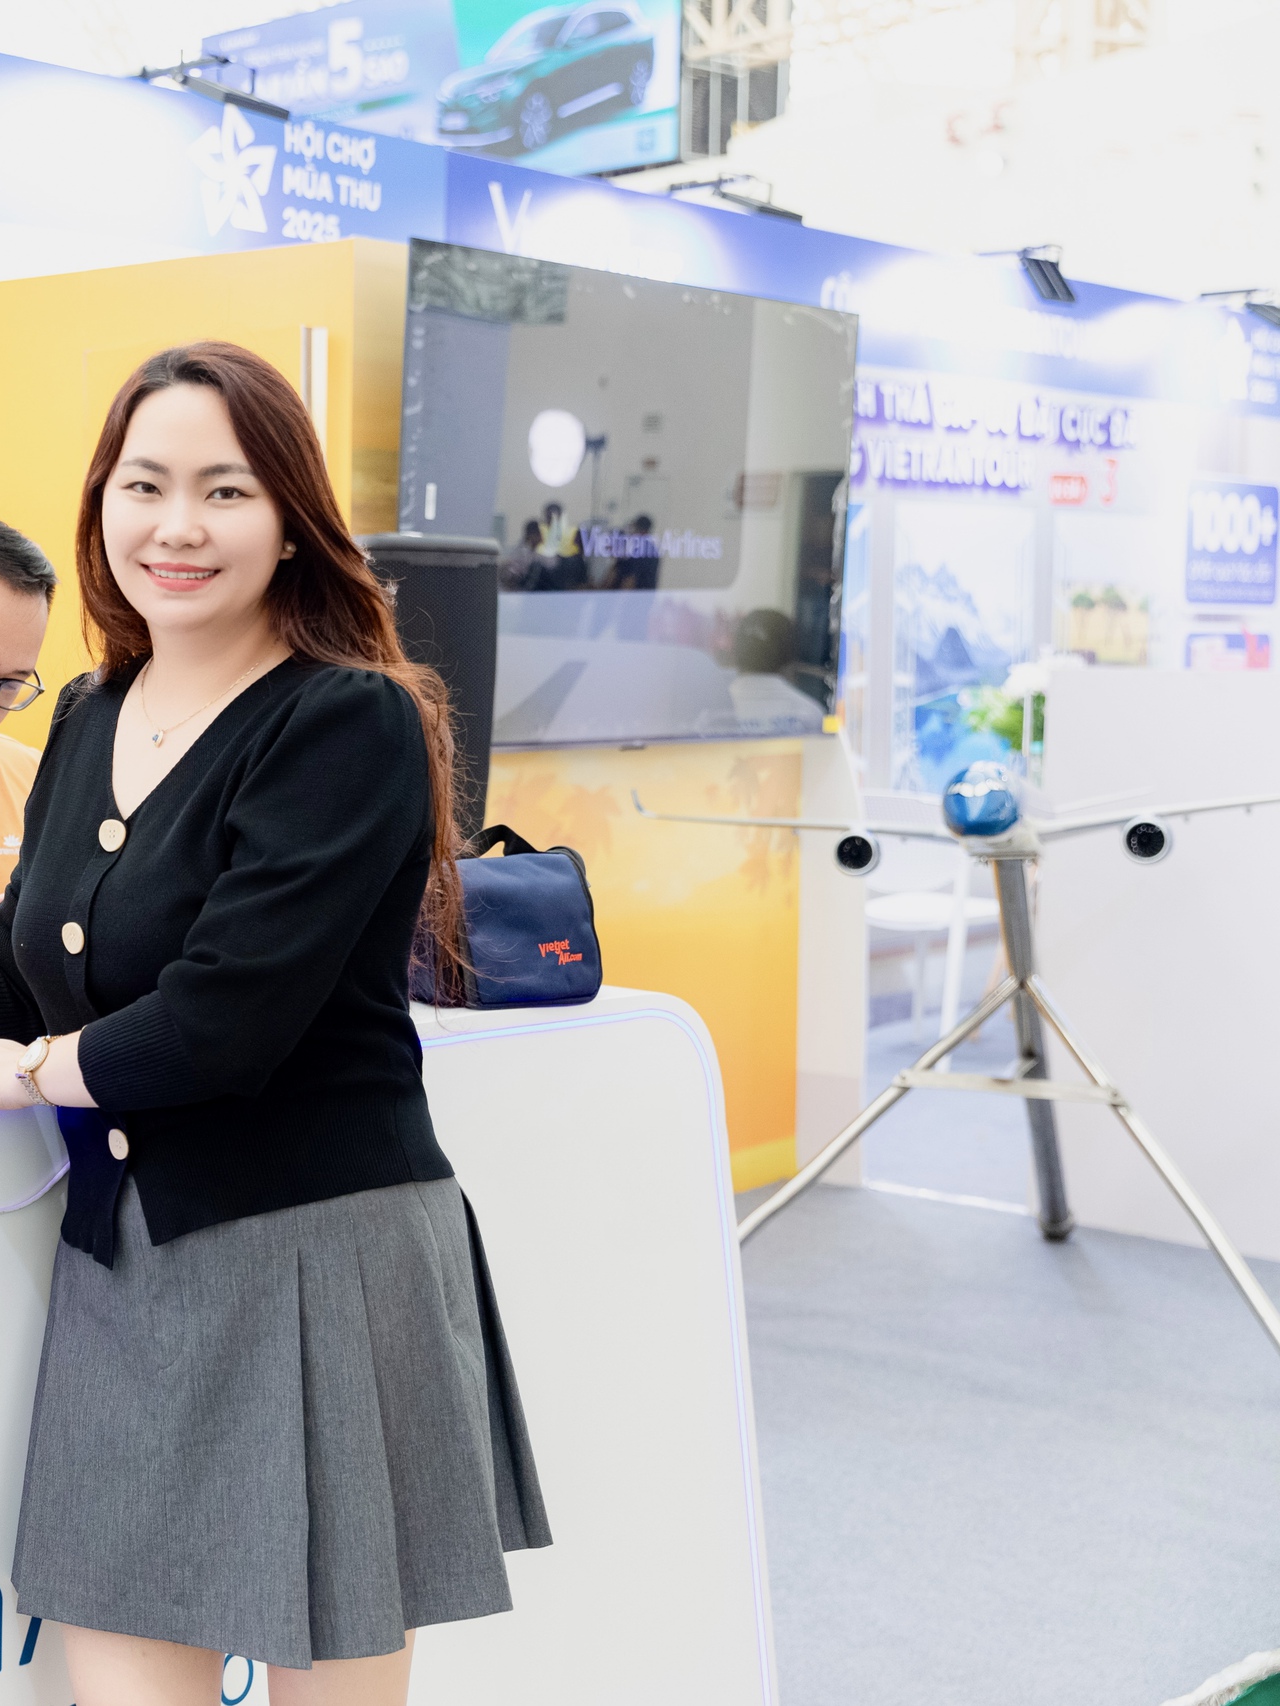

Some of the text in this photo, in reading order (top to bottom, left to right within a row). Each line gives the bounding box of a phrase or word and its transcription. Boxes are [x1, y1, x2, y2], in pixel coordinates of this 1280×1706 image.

[328, 16, 364, 97] 5
[283, 121, 376, 175] HỘI CHỢ
[283, 162, 382, 212] MÙA THU
[282, 206, 342, 242] 2025
[580, 525, 659, 559] Vietnam
[1190, 491, 1277, 555] 1000+
